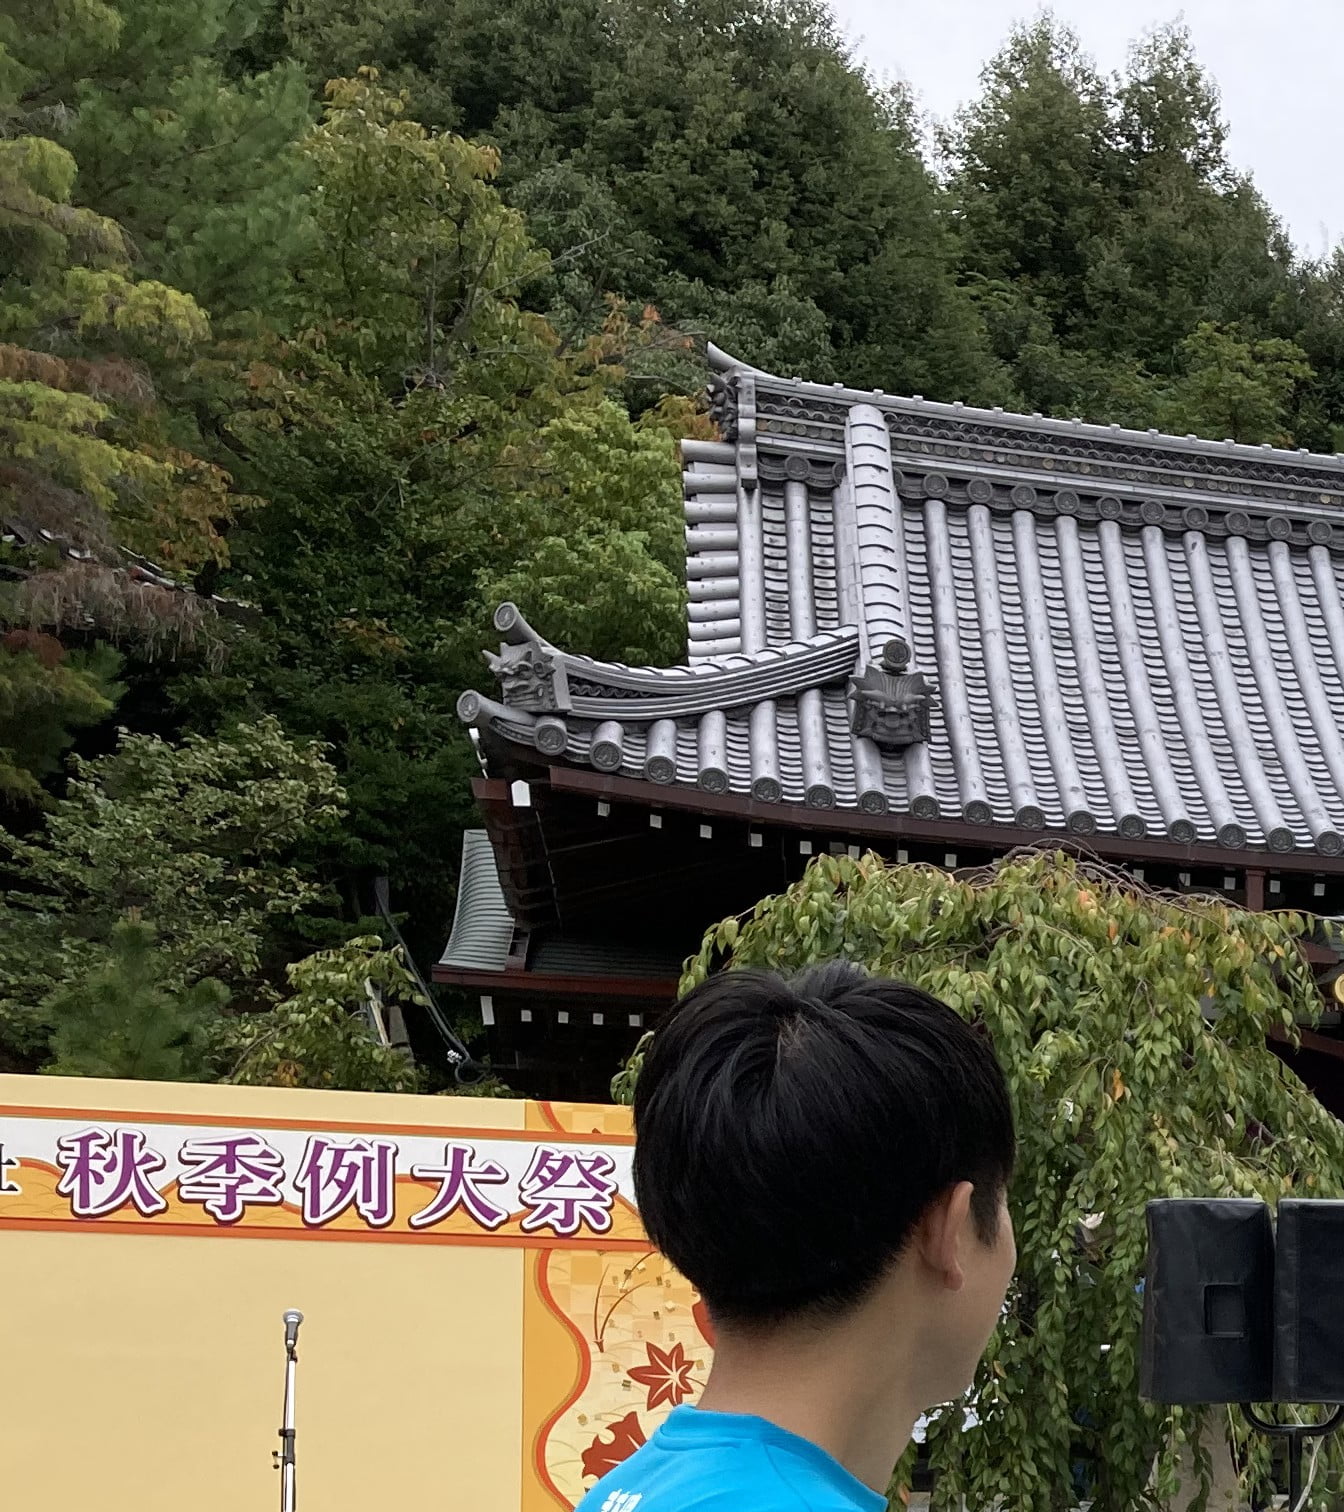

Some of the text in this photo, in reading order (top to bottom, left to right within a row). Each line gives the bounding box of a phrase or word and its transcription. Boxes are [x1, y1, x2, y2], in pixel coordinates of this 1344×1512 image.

[57, 1127, 620, 1236] 秋季例大祭
